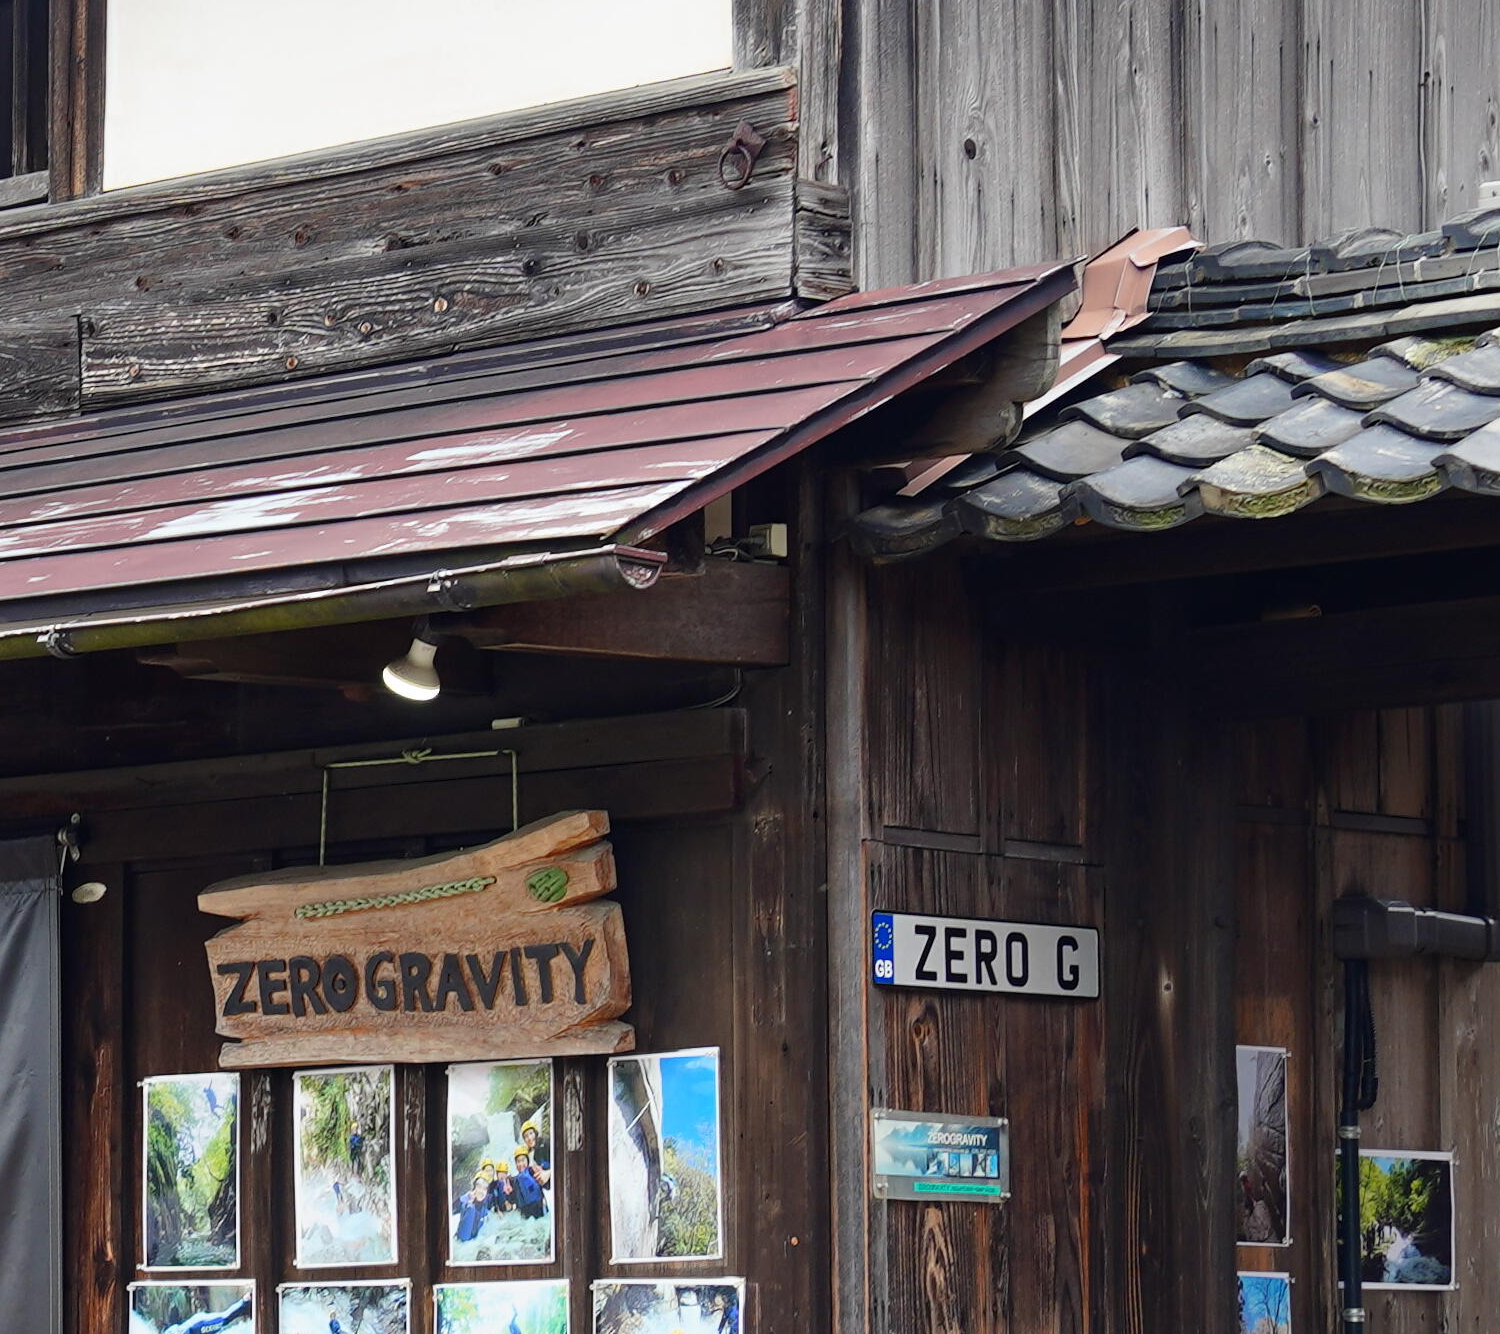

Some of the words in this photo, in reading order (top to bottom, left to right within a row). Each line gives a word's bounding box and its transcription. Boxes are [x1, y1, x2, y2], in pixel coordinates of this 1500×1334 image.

[216, 954, 357, 1018] ZERO
[365, 939, 597, 1013] GRAVITY
[875, 959, 893, 978] GB
[914, 924, 1029, 987] ZERO
[1057, 935, 1079, 991] G
